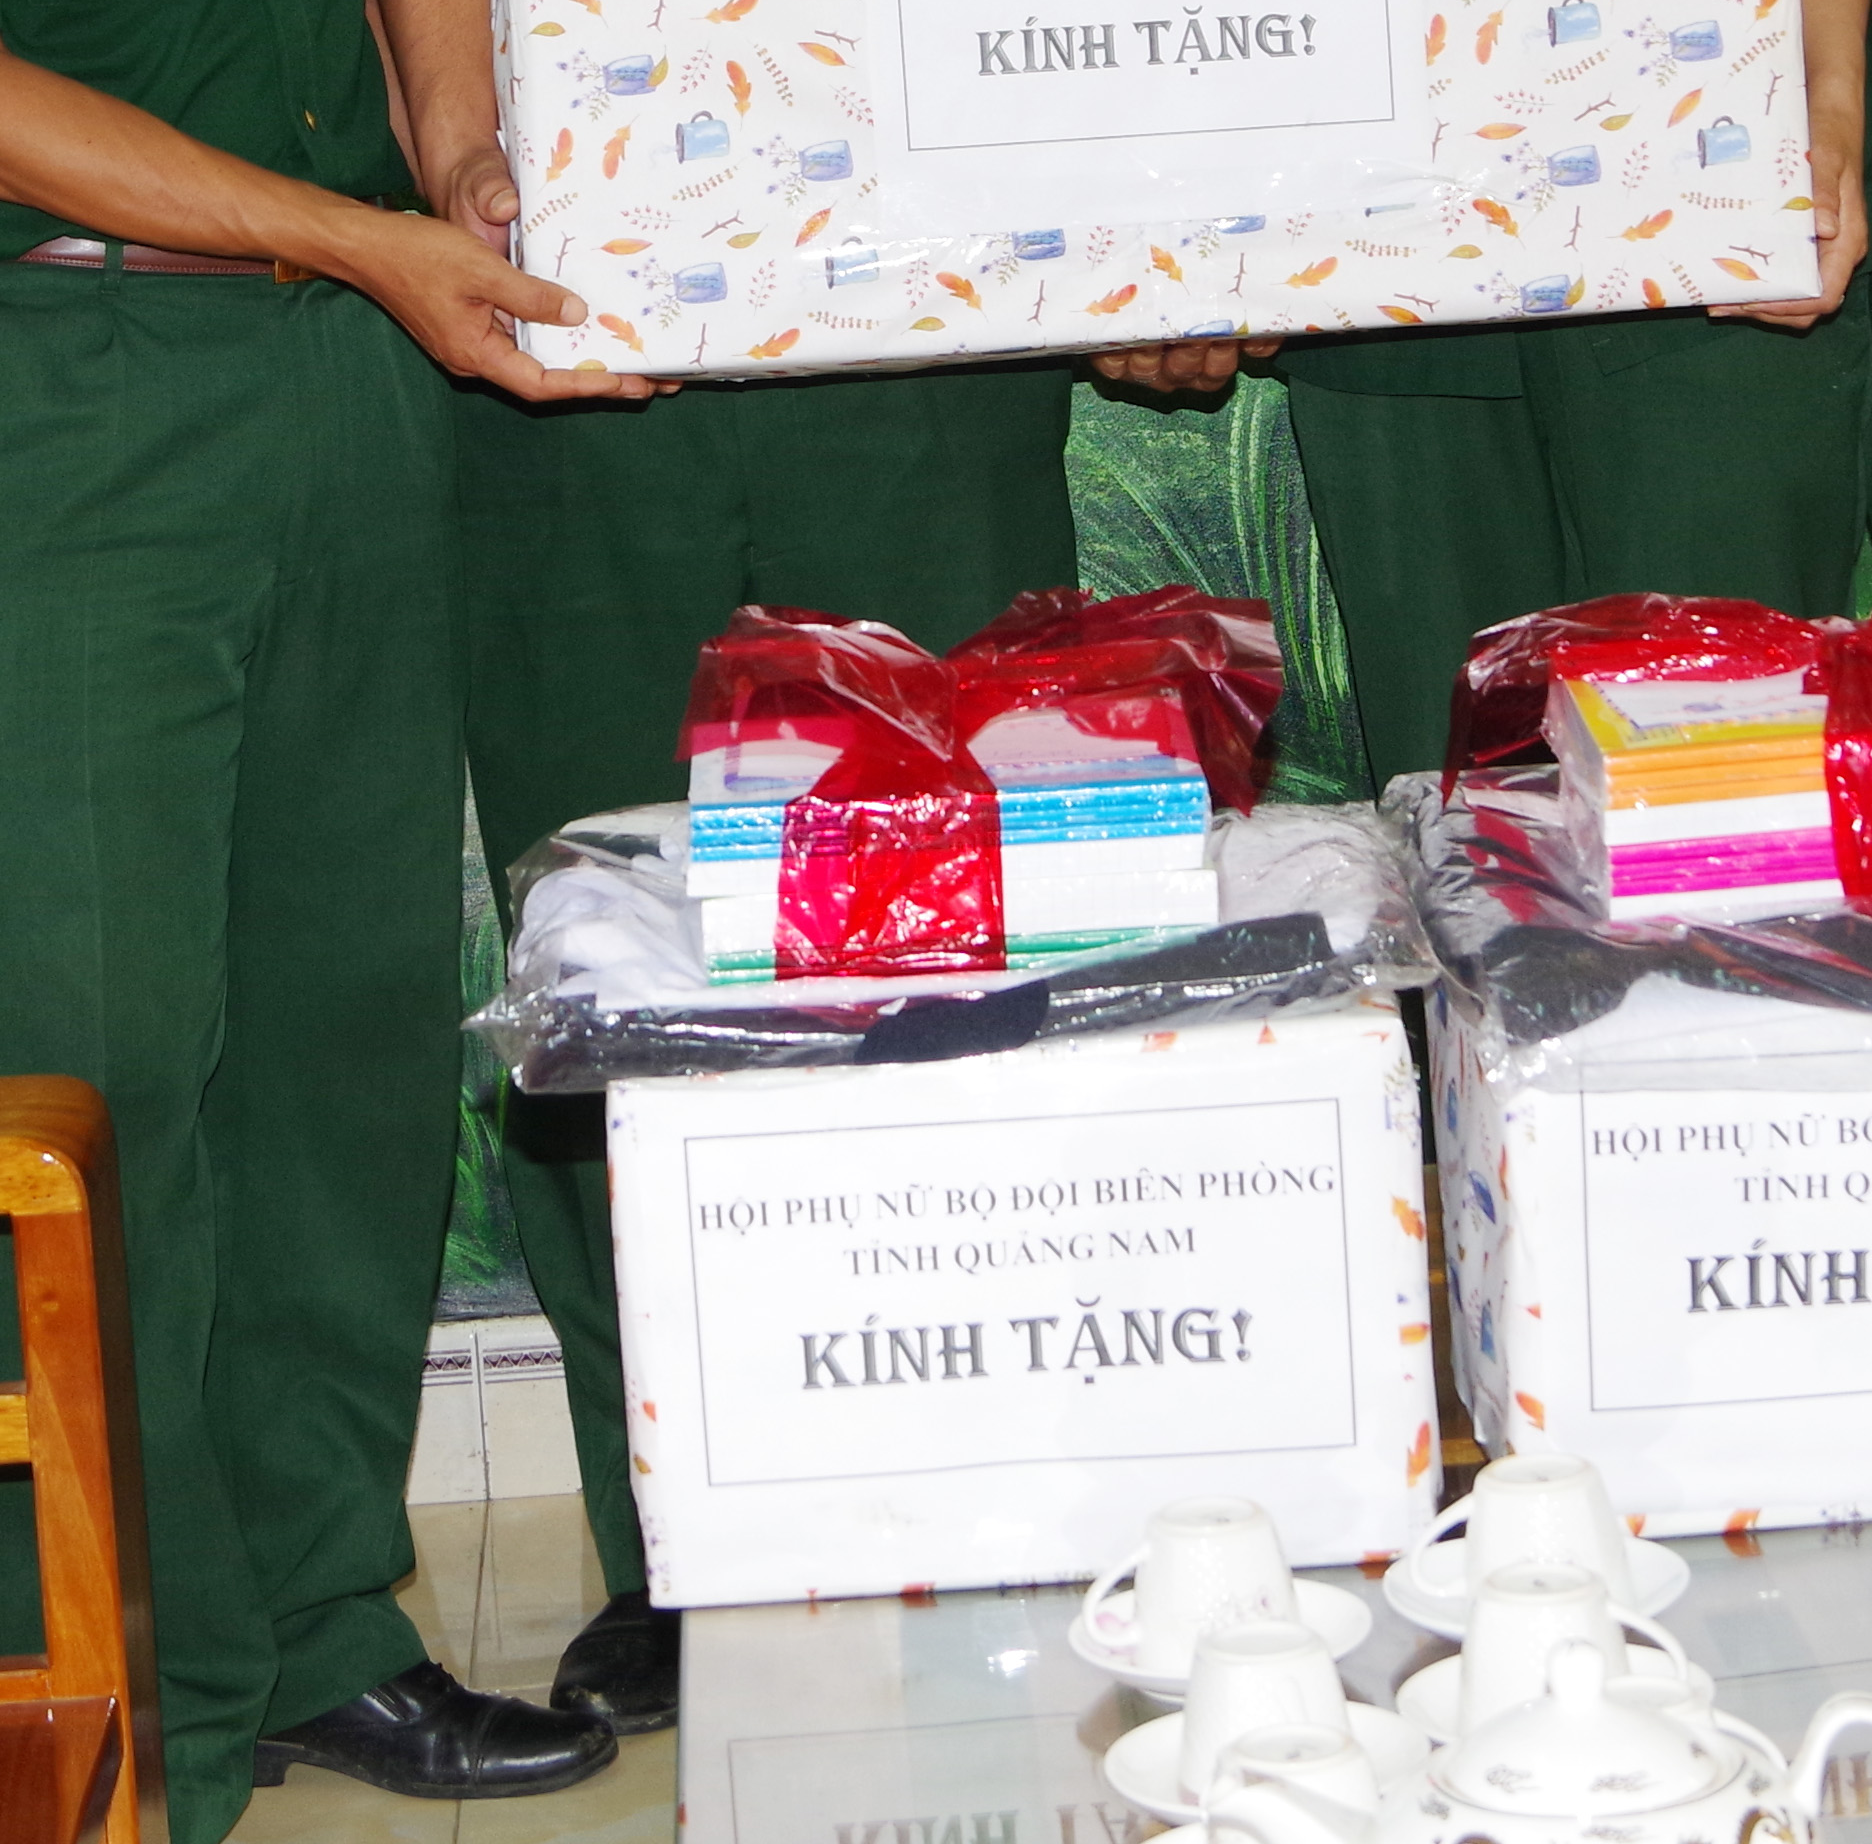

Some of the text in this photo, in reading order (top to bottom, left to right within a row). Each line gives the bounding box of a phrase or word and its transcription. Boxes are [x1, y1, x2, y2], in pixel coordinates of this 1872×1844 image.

[976, 5, 1317, 76] KÍNH TẶNG!
[1593, 1122, 1662, 1162] HỘI
[1678, 1123, 1752, 1157] PHỤ
[1769, 1113, 1825, 1148] NỮ
[699, 1161, 1334, 1236] HỘI PHỤ NỮ BỘ ĐỘI BIÊN PHÒNG
[1734, 1168, 1829, 1203] TỈNH
[843, 1227, 1195, 1276] TỈNH QUẢNG NAM
[1685, 1238, 1872, 1314] KÍNH
[798, 1295, 1253, 1391] KÍNH TẶNG!
